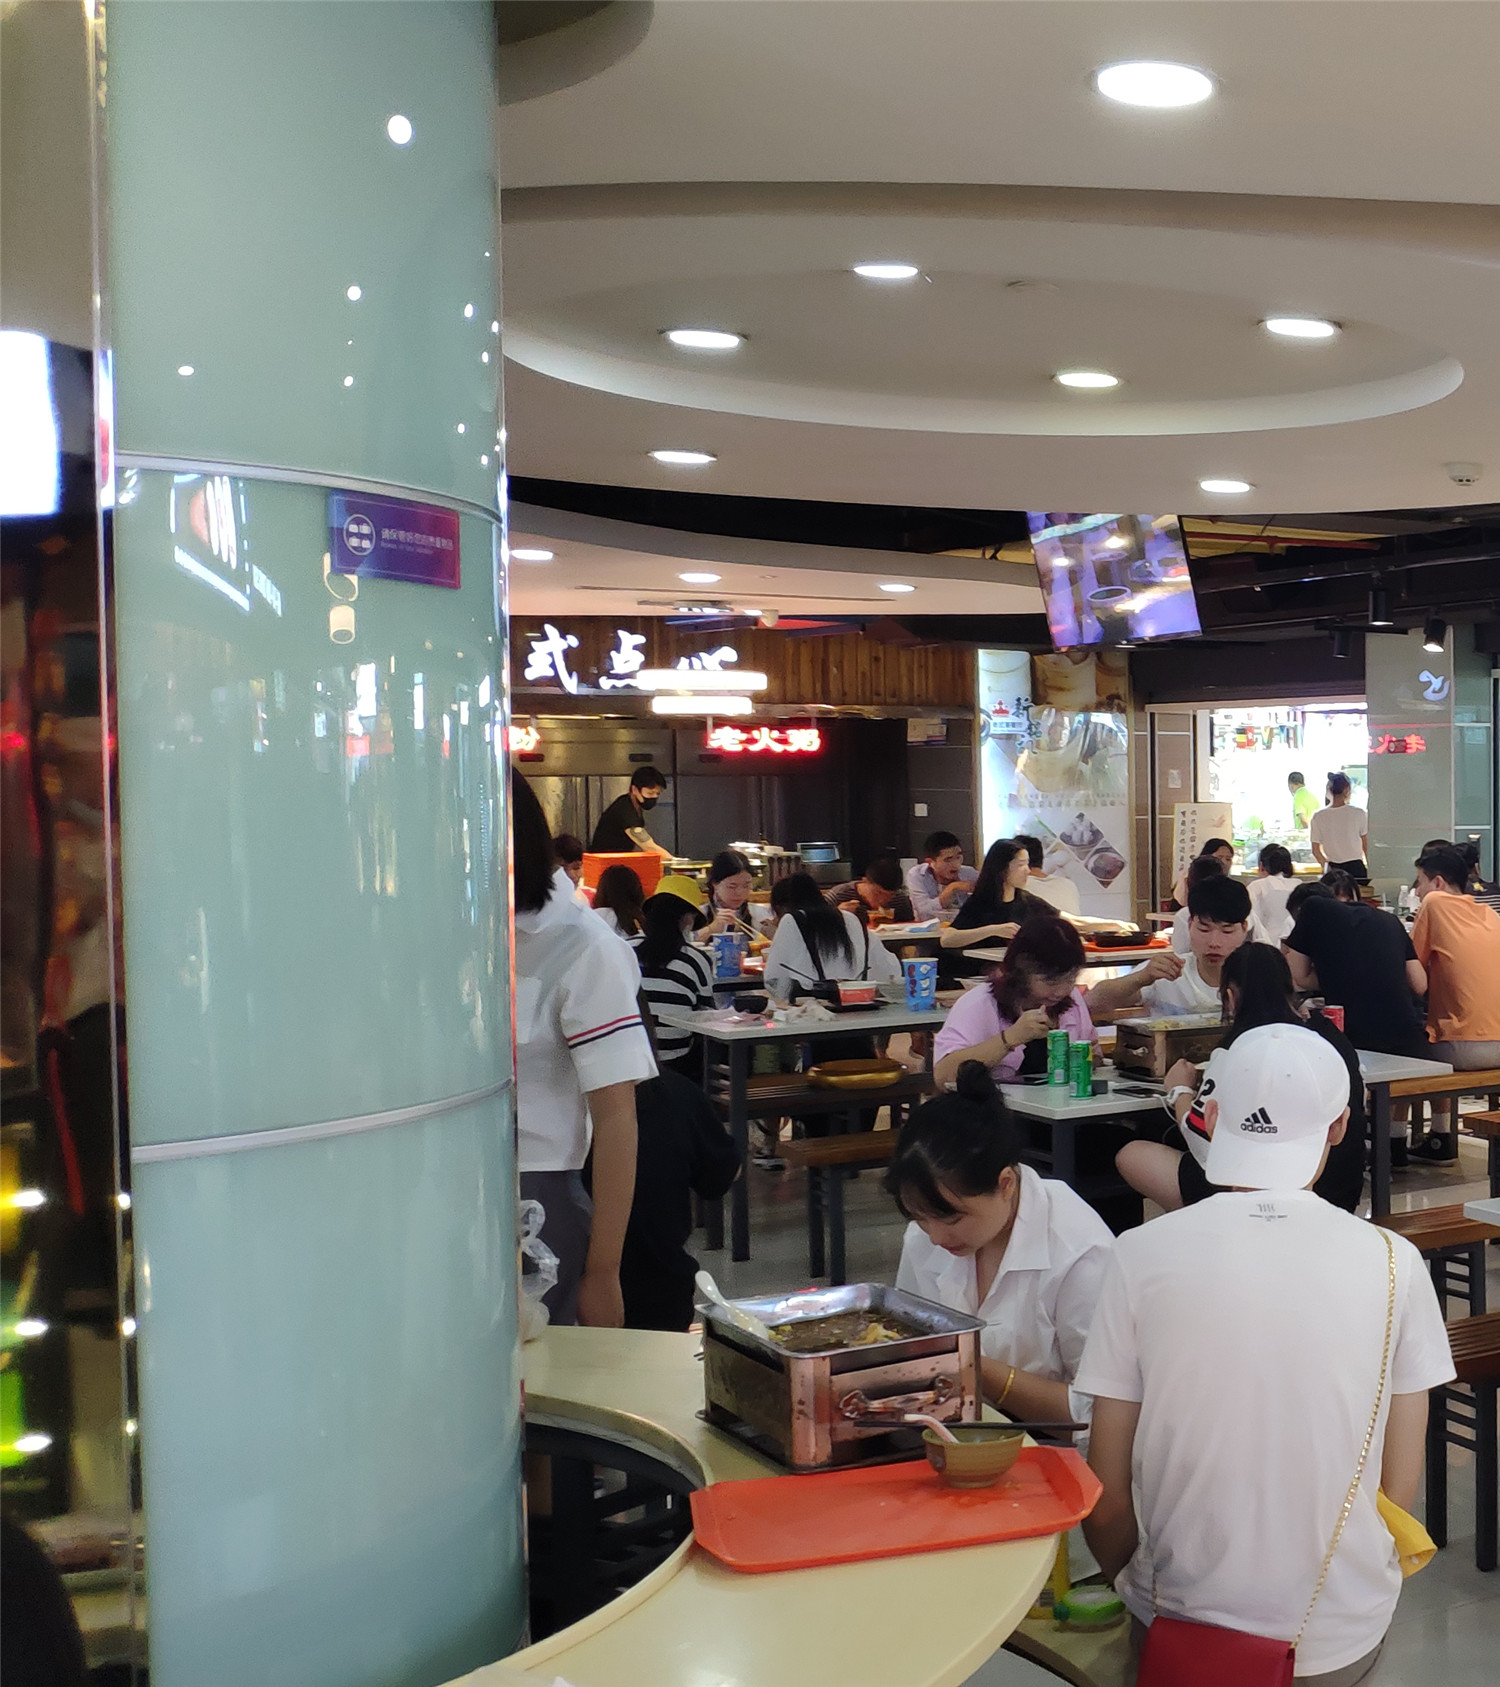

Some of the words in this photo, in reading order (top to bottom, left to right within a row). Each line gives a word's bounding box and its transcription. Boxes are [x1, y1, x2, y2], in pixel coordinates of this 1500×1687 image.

[709, 725, 821, 752] 老火粥
[1240, 1121, 1278, 1134] adidas
